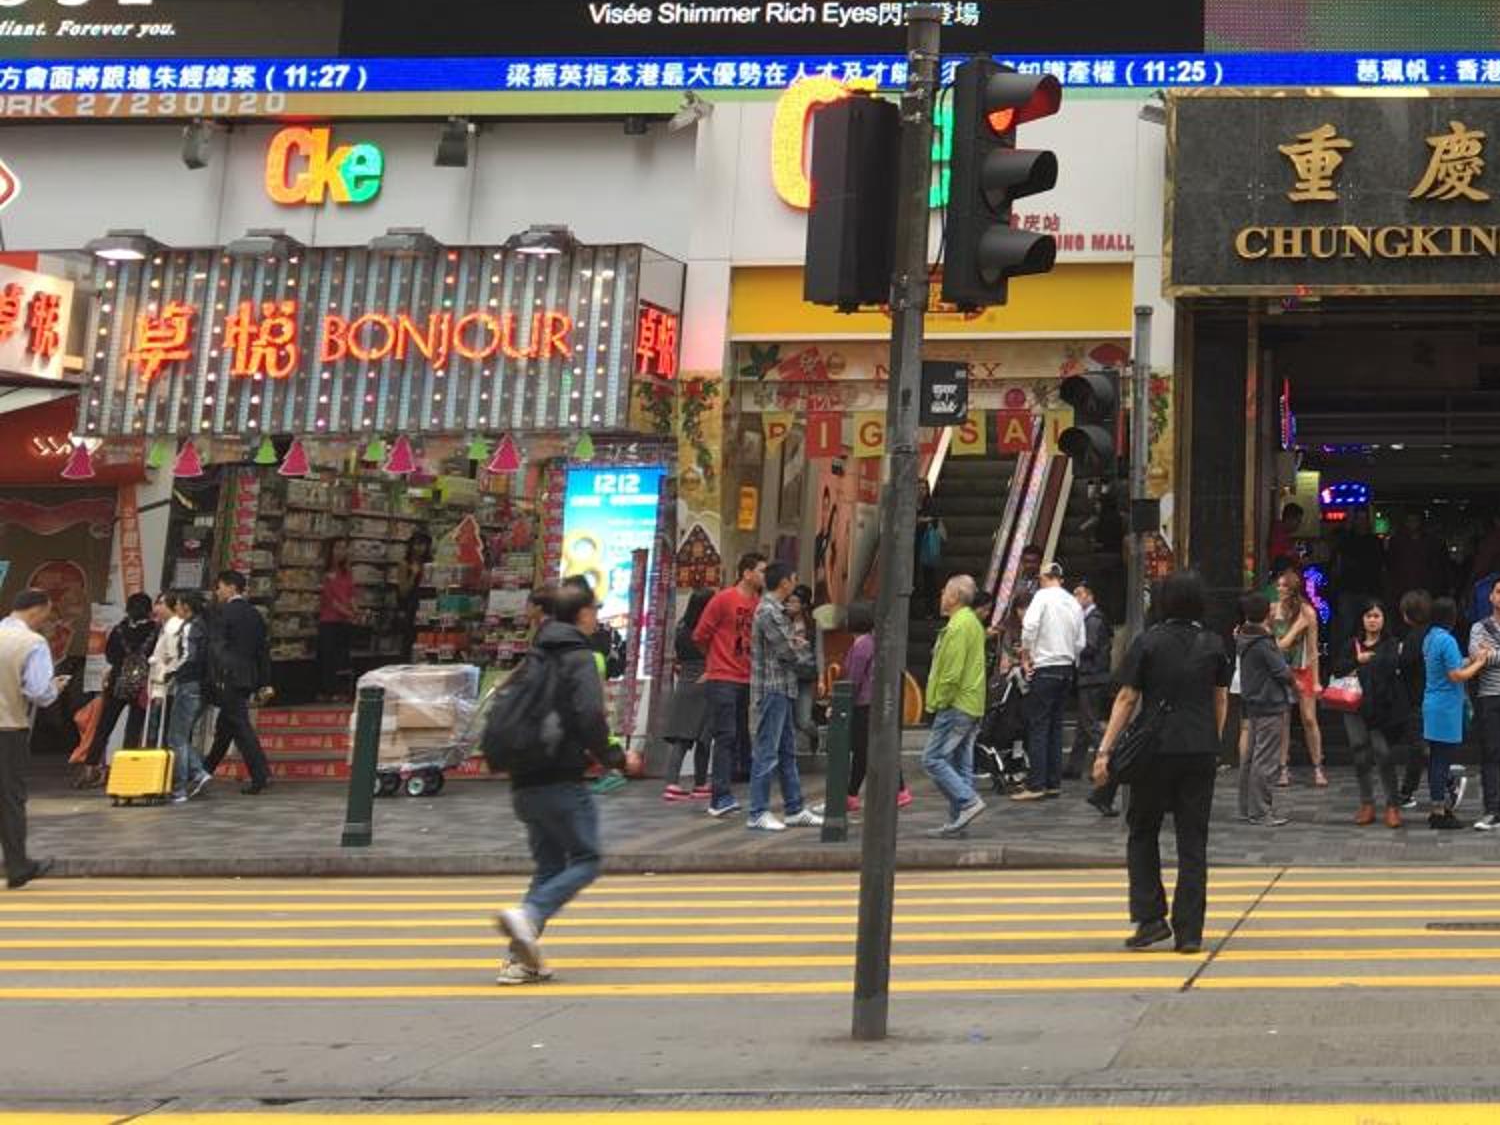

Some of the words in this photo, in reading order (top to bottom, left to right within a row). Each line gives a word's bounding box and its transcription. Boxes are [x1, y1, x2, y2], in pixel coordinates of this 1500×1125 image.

[589, 3, 652, 25] Visée
[658, 3, 760, 25] Shimmer
[766, 3, 816, 24] Rich
[56, 20, 134, 36] Forever
[1092, 235, 1134, 251] MALL
[319, 312, 574, 369] BONJOUR
